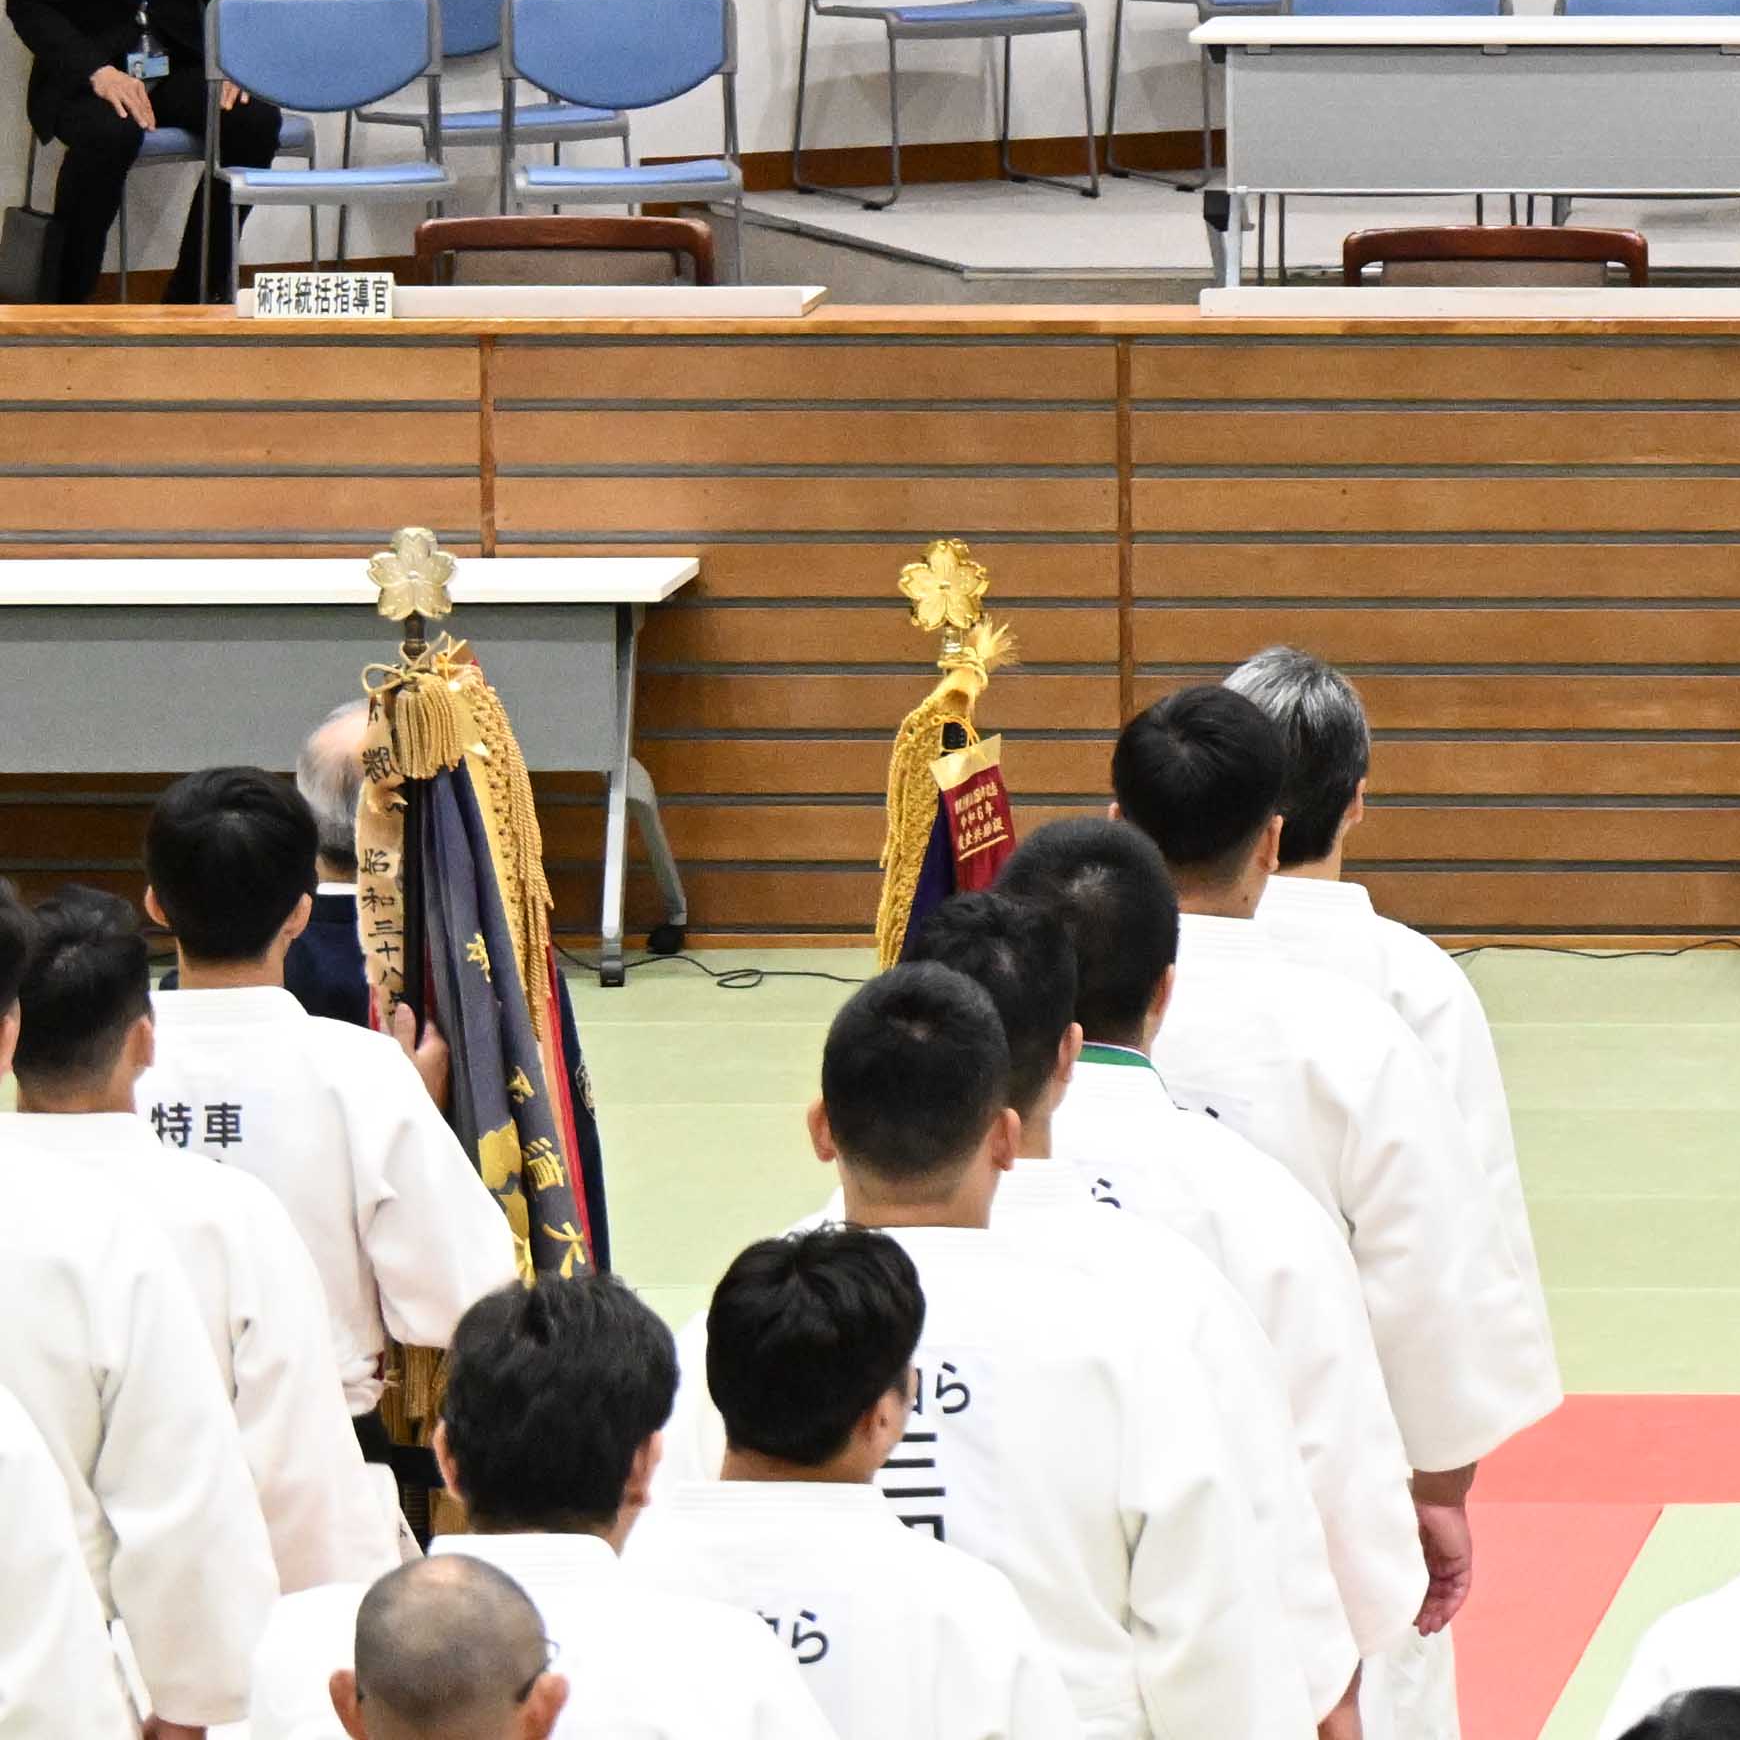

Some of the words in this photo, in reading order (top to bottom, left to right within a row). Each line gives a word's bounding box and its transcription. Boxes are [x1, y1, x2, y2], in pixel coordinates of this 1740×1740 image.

[257, 276, 389, 314] 術科統括指導官
[151, 1102, 243, 1148] 特車
